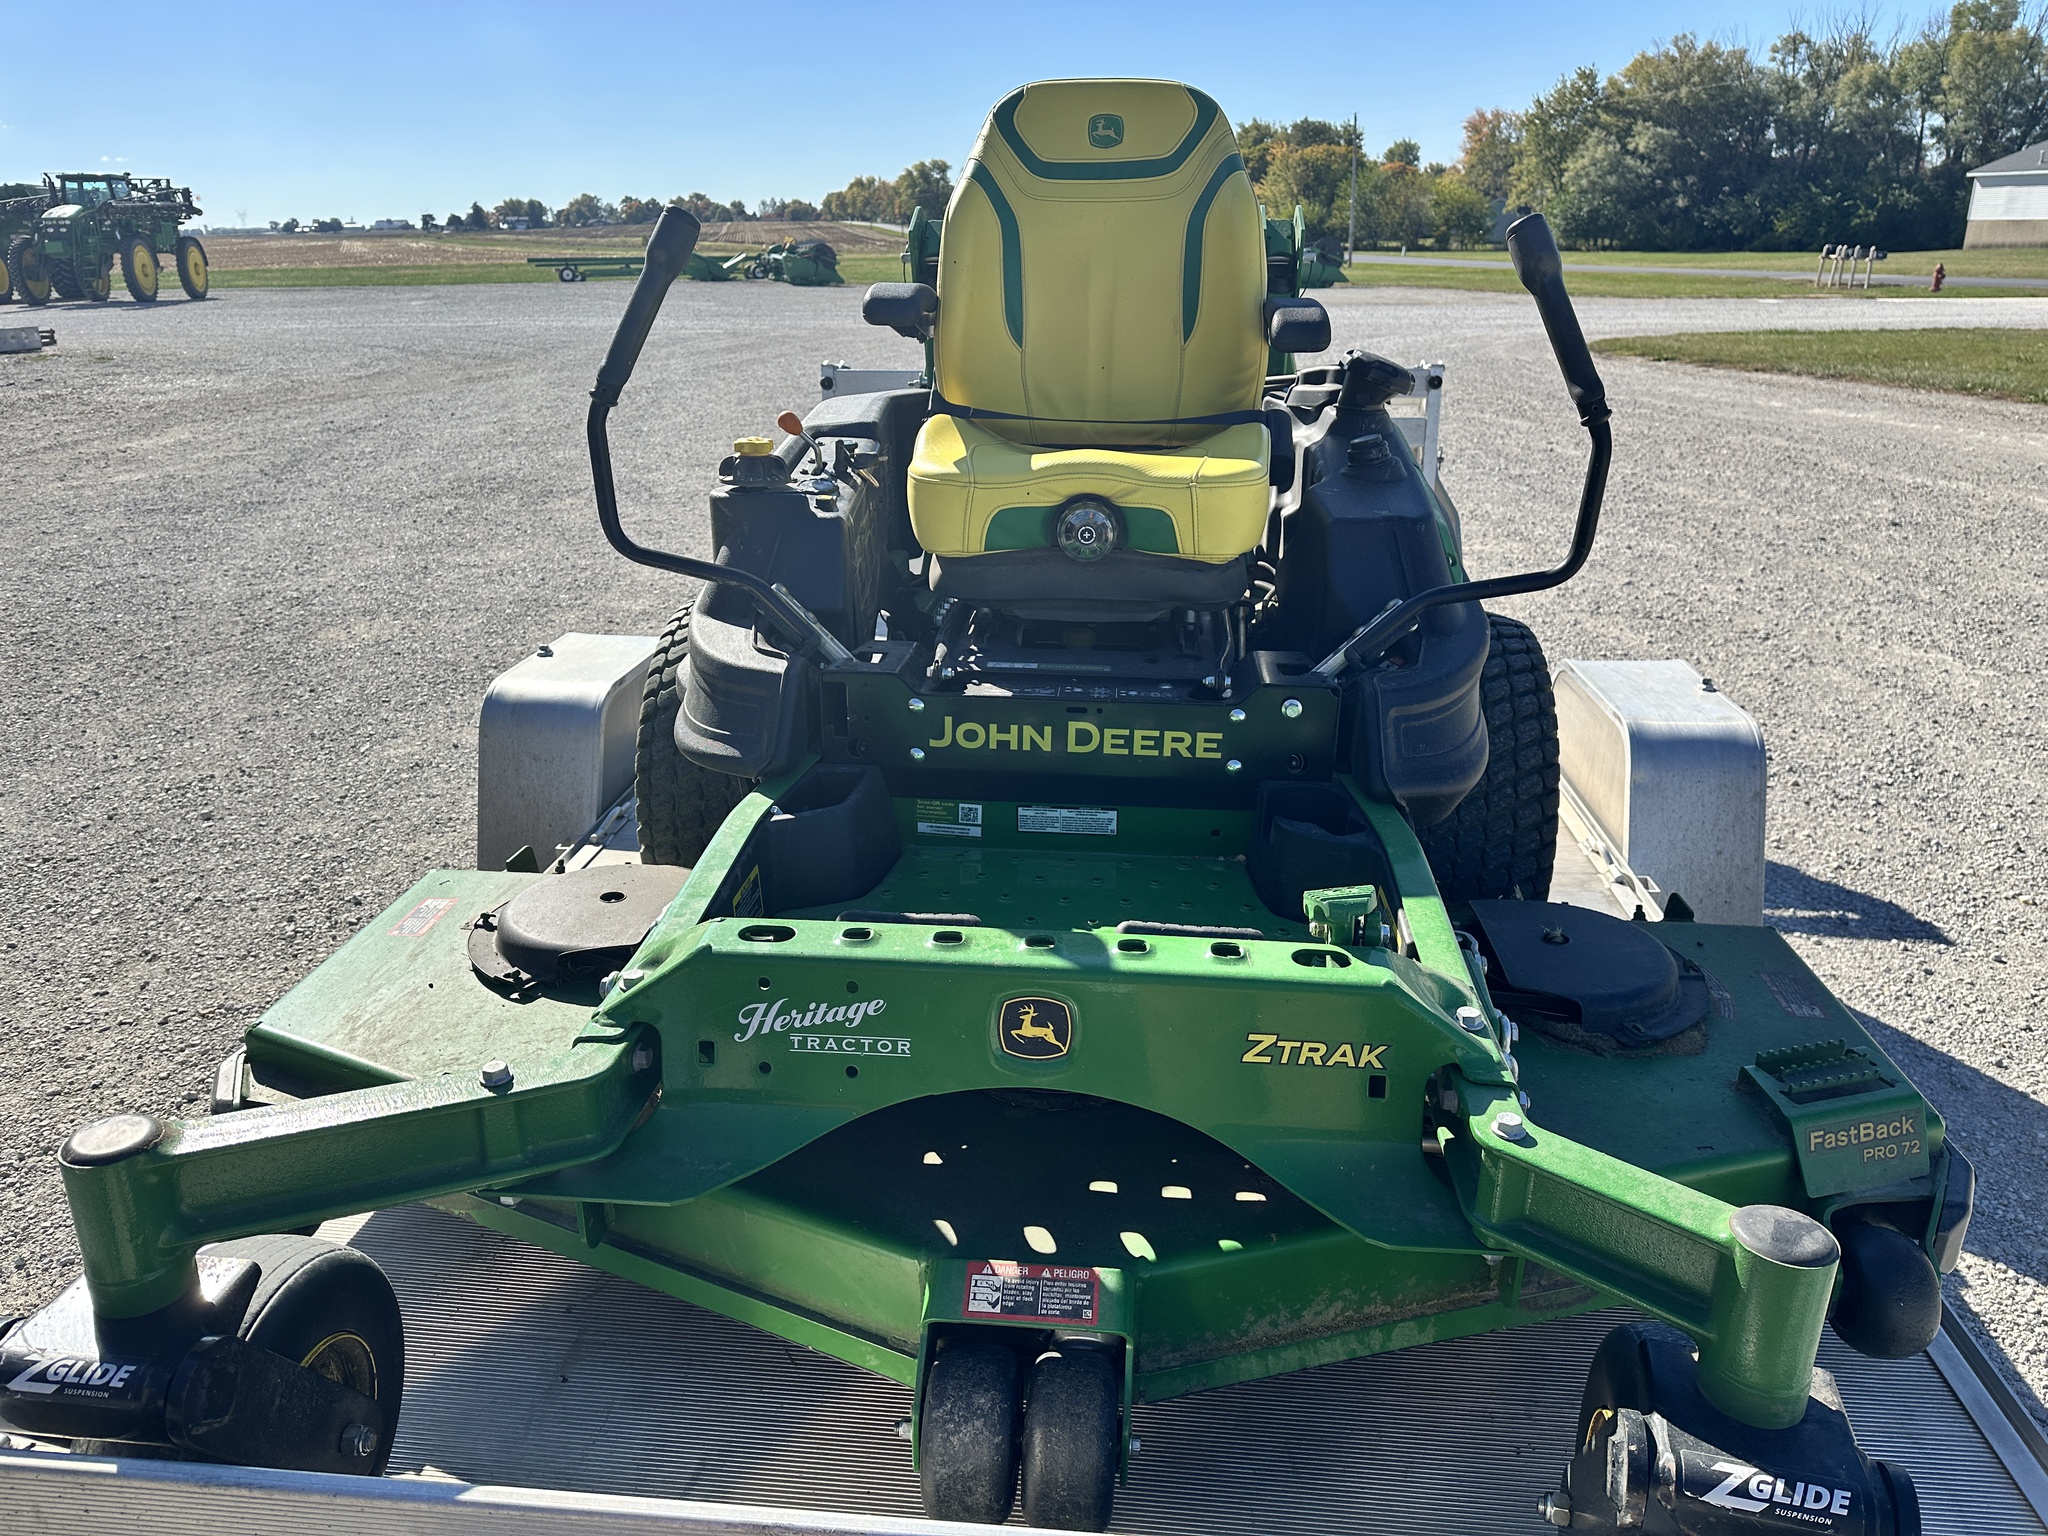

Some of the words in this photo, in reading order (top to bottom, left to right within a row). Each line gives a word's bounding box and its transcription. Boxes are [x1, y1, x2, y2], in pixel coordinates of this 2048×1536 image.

[929, 716, 1051, 752] JOHN
[1067, 720, 1223, 759] DEERE
[734, 998, 886, 1042] Heritage
[790, 1036, 911, 1054] TRACTOR
[1241, 1033, 1389, 1069] ZTRAK
[1810, 1116, 1914, 1151] FastBack
[1863, 1144, 1897, 1162] PRO
[1901, 1140, 1920, 1155] 72
[995, 1265, 1028, 1275] DANGER
[1054, 1269, 1089, 1279] PELIGRO
[63, 1387, 110, 1398] SUSPENSION
[1774, 1508, 1832, 1525] SUSPENSION
